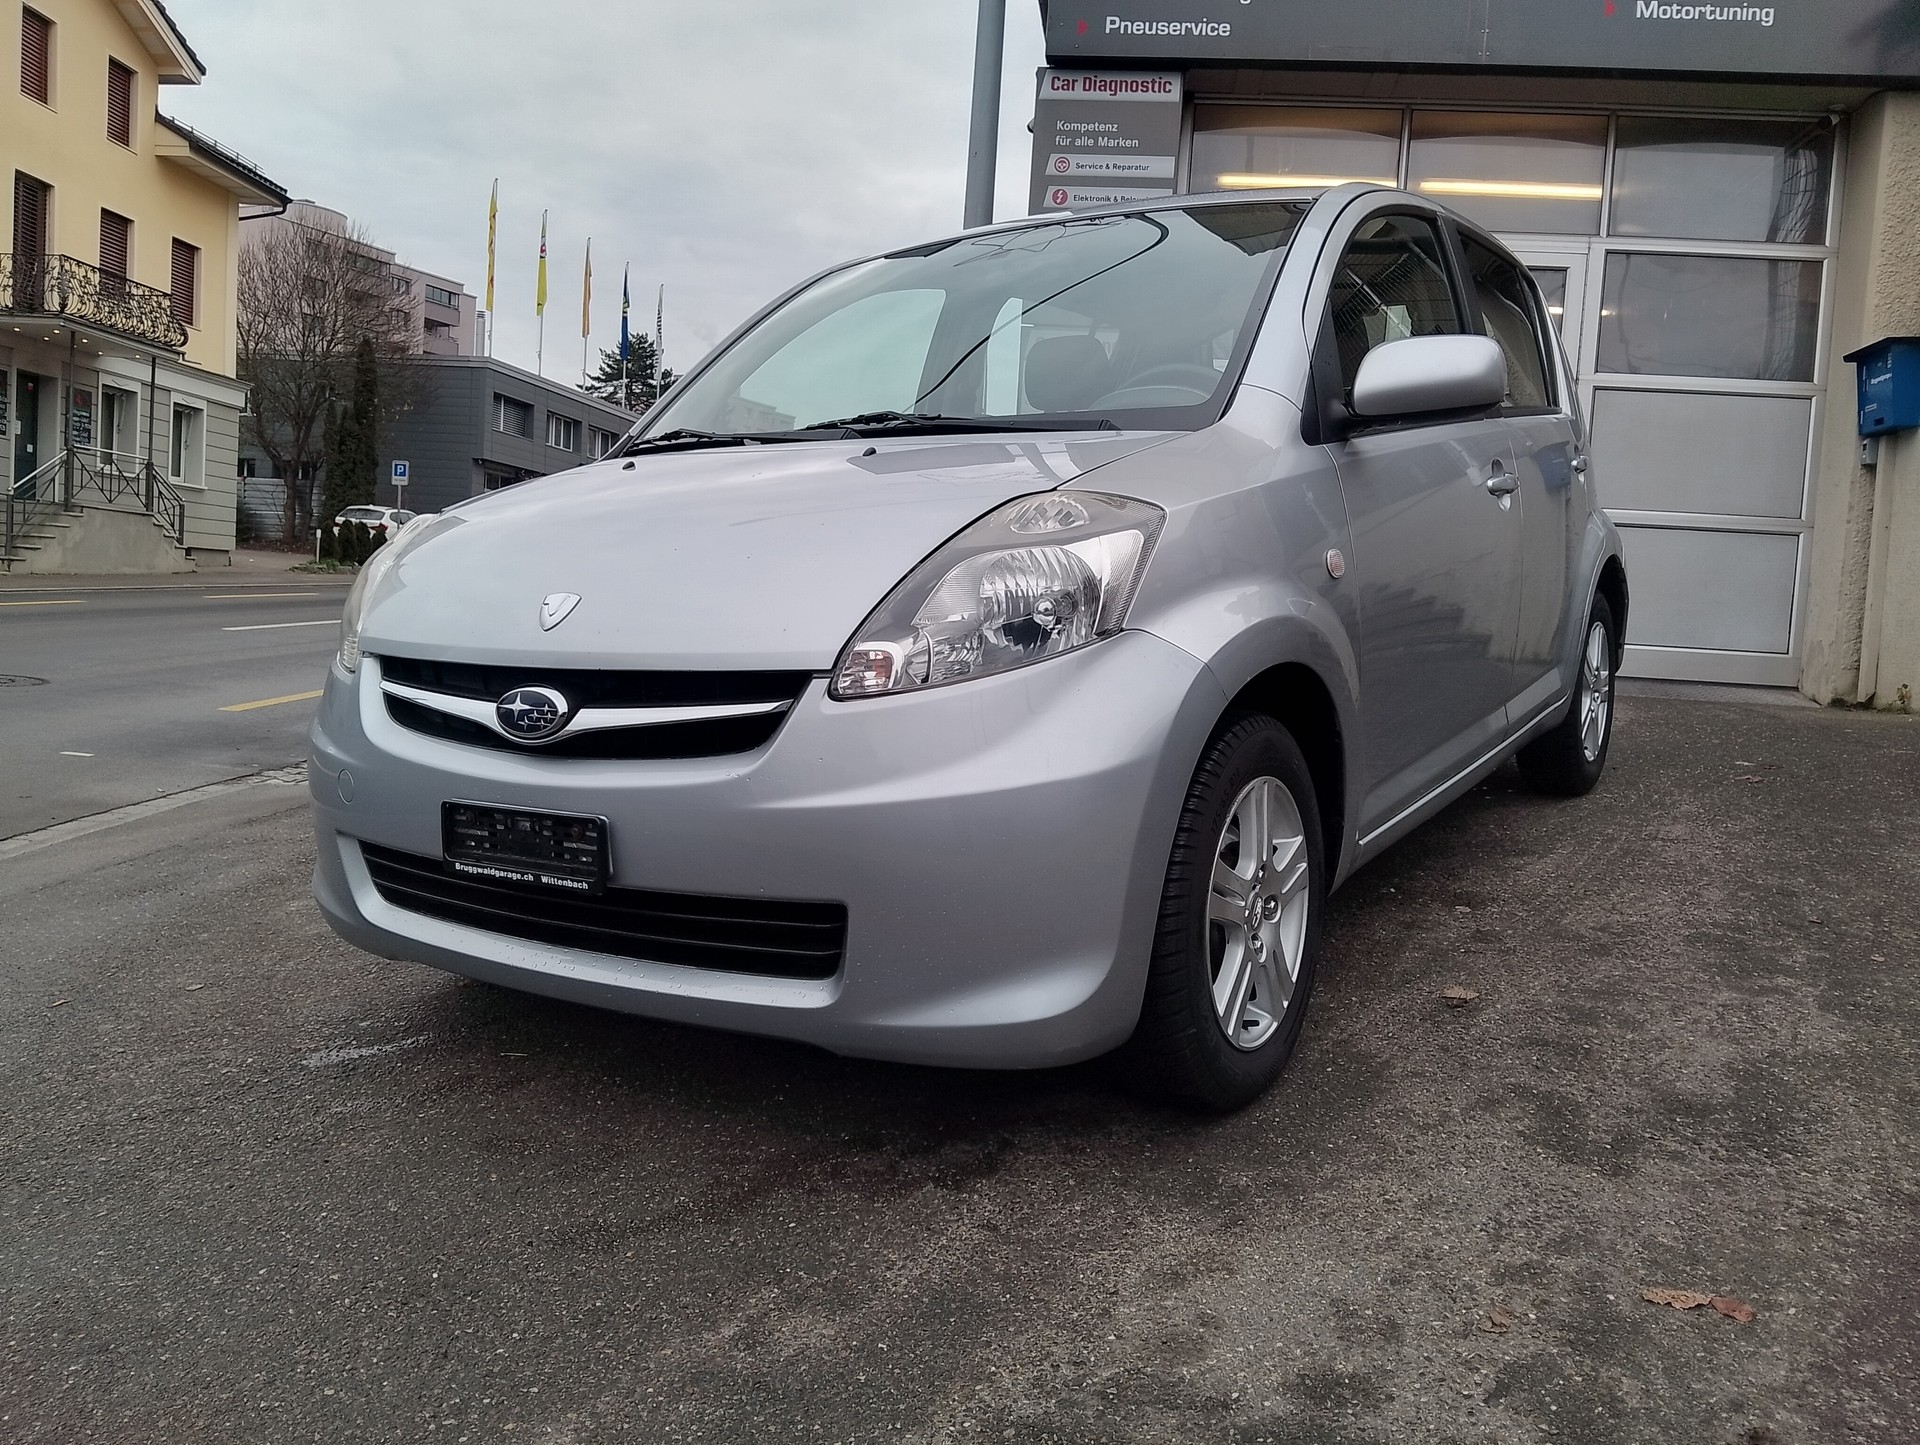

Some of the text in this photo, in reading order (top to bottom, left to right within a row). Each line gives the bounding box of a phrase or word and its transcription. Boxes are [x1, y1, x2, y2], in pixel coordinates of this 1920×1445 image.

[1636, 0, 1775, 26] Motortuning
[1105, 16, 1231, 37] Pneuservice
[1050, 75, 1173, 96] Car Diagnostic
[1056, 121, 1118, 133] Kompetenz
[1055, 135, 1139, 147] für alle Marken
[1075, 162, 1104, 170] Service
[1112, 163, 1150, 172] Reparatur
[1073, 194, 1112, 203] Elektronik
[397, 465, 404, 475] P
[455, 862, 589, 890] Bruggwaldgarage.ch Wittenbach
